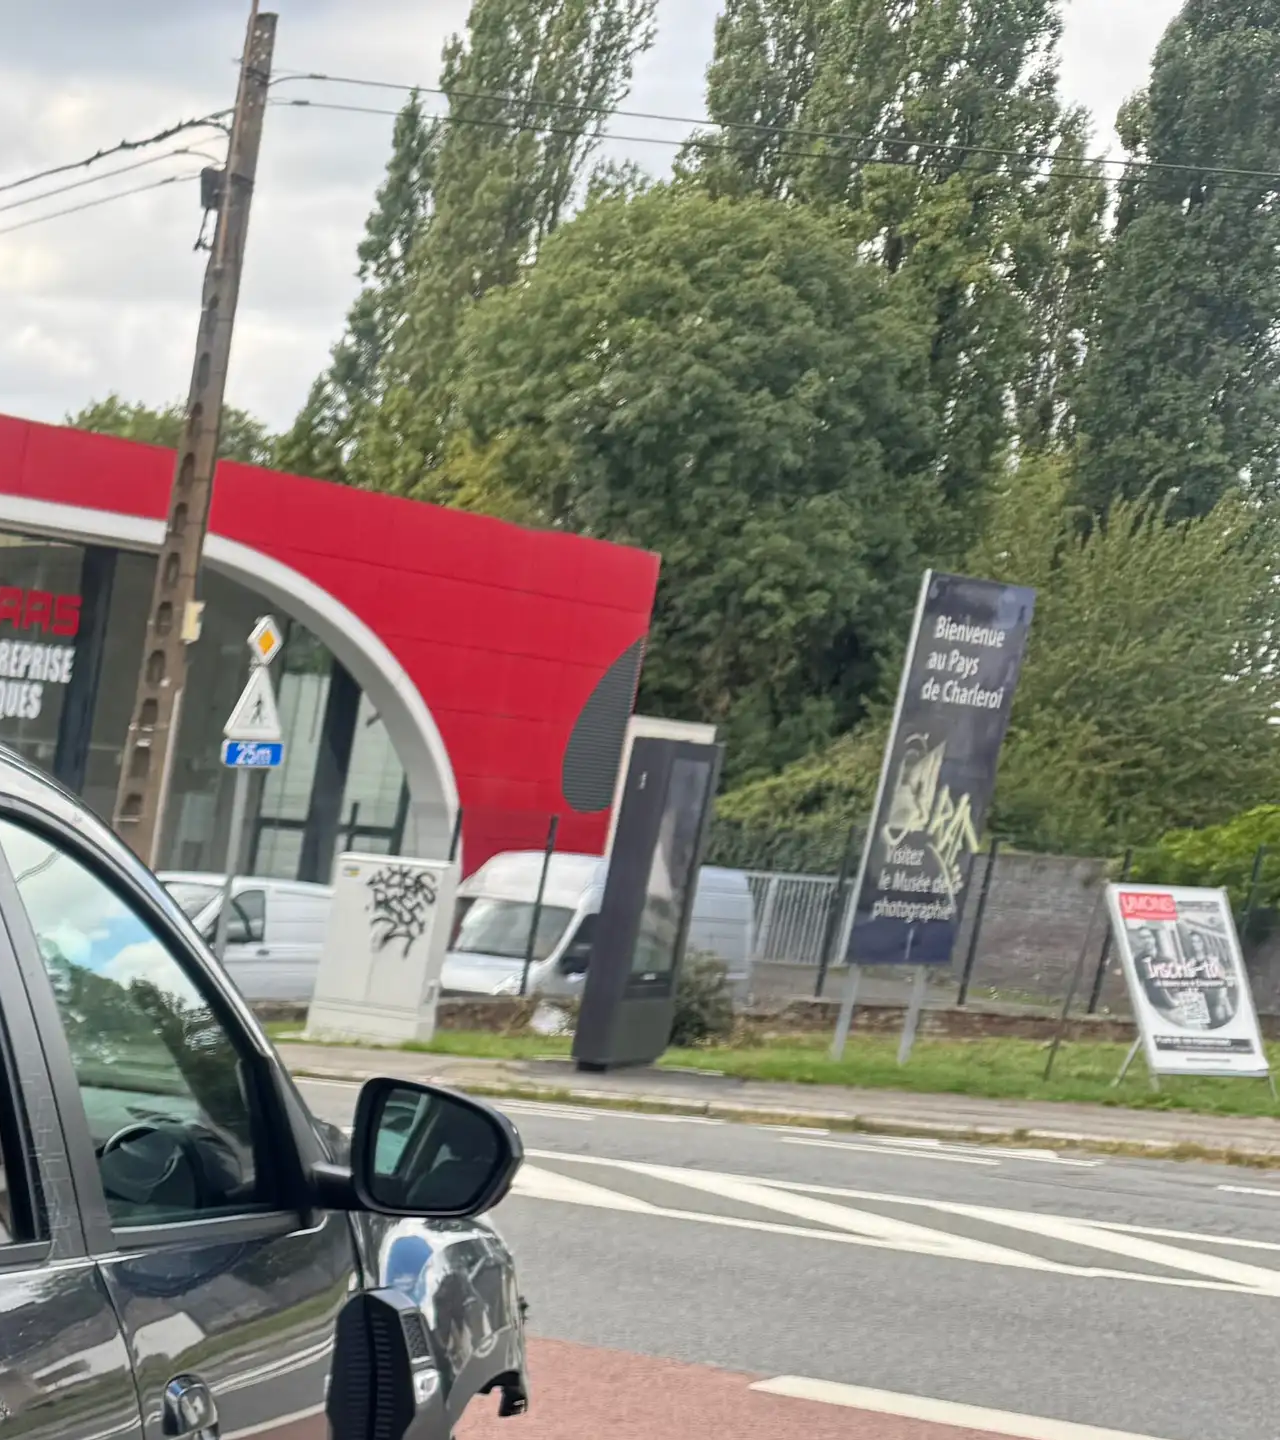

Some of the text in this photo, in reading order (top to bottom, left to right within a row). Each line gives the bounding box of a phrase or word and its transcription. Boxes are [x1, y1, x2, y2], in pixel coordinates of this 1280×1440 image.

[934, 614, 1006, 648] Bienvenue
[927, 649, 981, 679] au Pays
[921, 676, 1005, 709] de Charleroi
[236, 743, 272, 766] 25m
